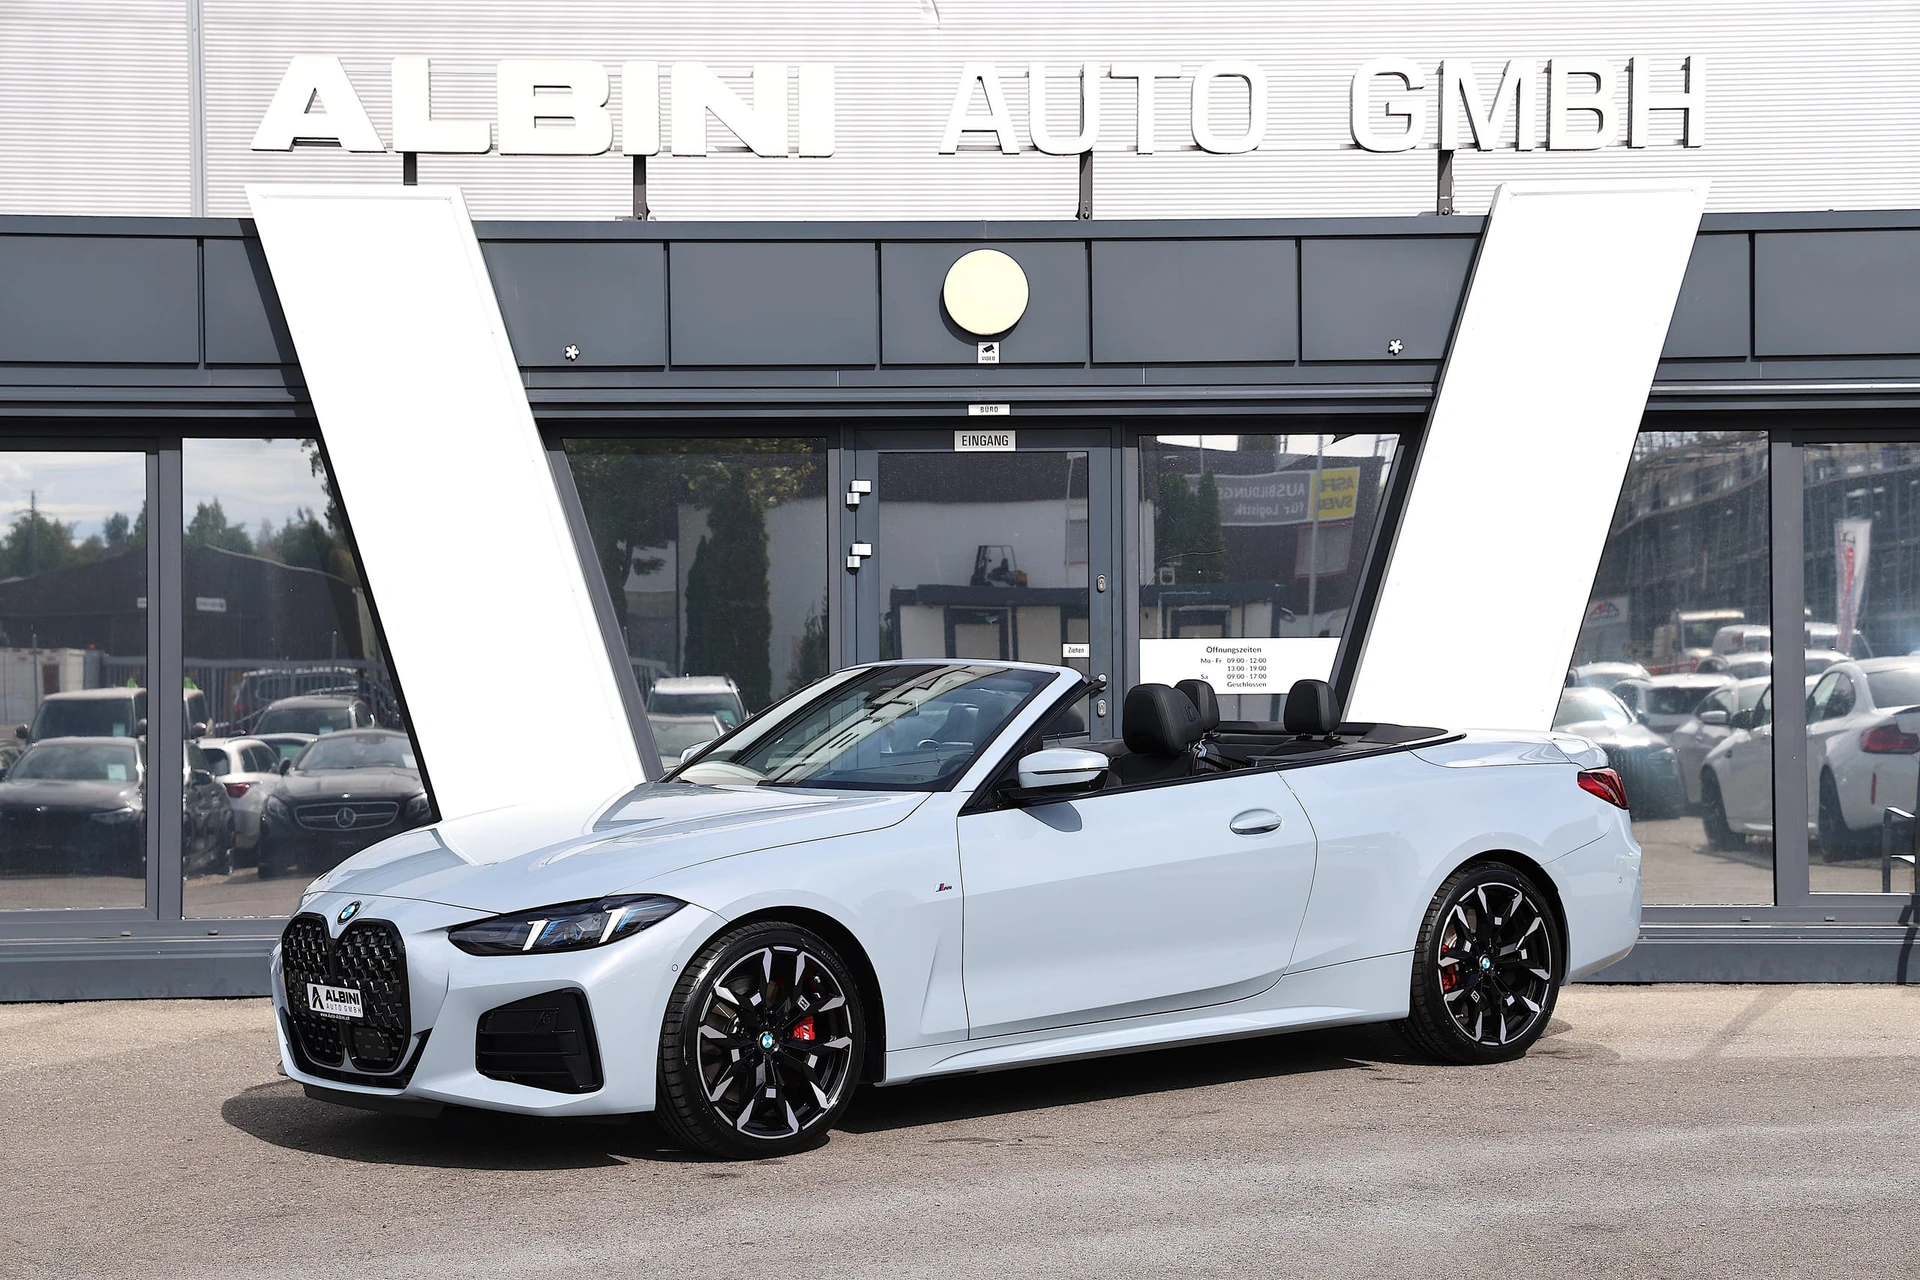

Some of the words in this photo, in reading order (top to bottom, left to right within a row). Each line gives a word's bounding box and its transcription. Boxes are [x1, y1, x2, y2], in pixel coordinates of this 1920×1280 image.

[250, 54, 836, 158] ALBINI
[939, 58, 1268, 156] AUTO
[1349, 54, 1706, 153] GMBH
[980, 405, 999, 413] BÜRO
[961, 435, 1009, 446] EINGANG
[1206, 645, 1262, 654] Öffnungszeiten
[326, 989, 360, 1005] ALBINI
[326, 1003, 342, 1012] AUTO
[344, 1005, 362, 1014] GMBH
